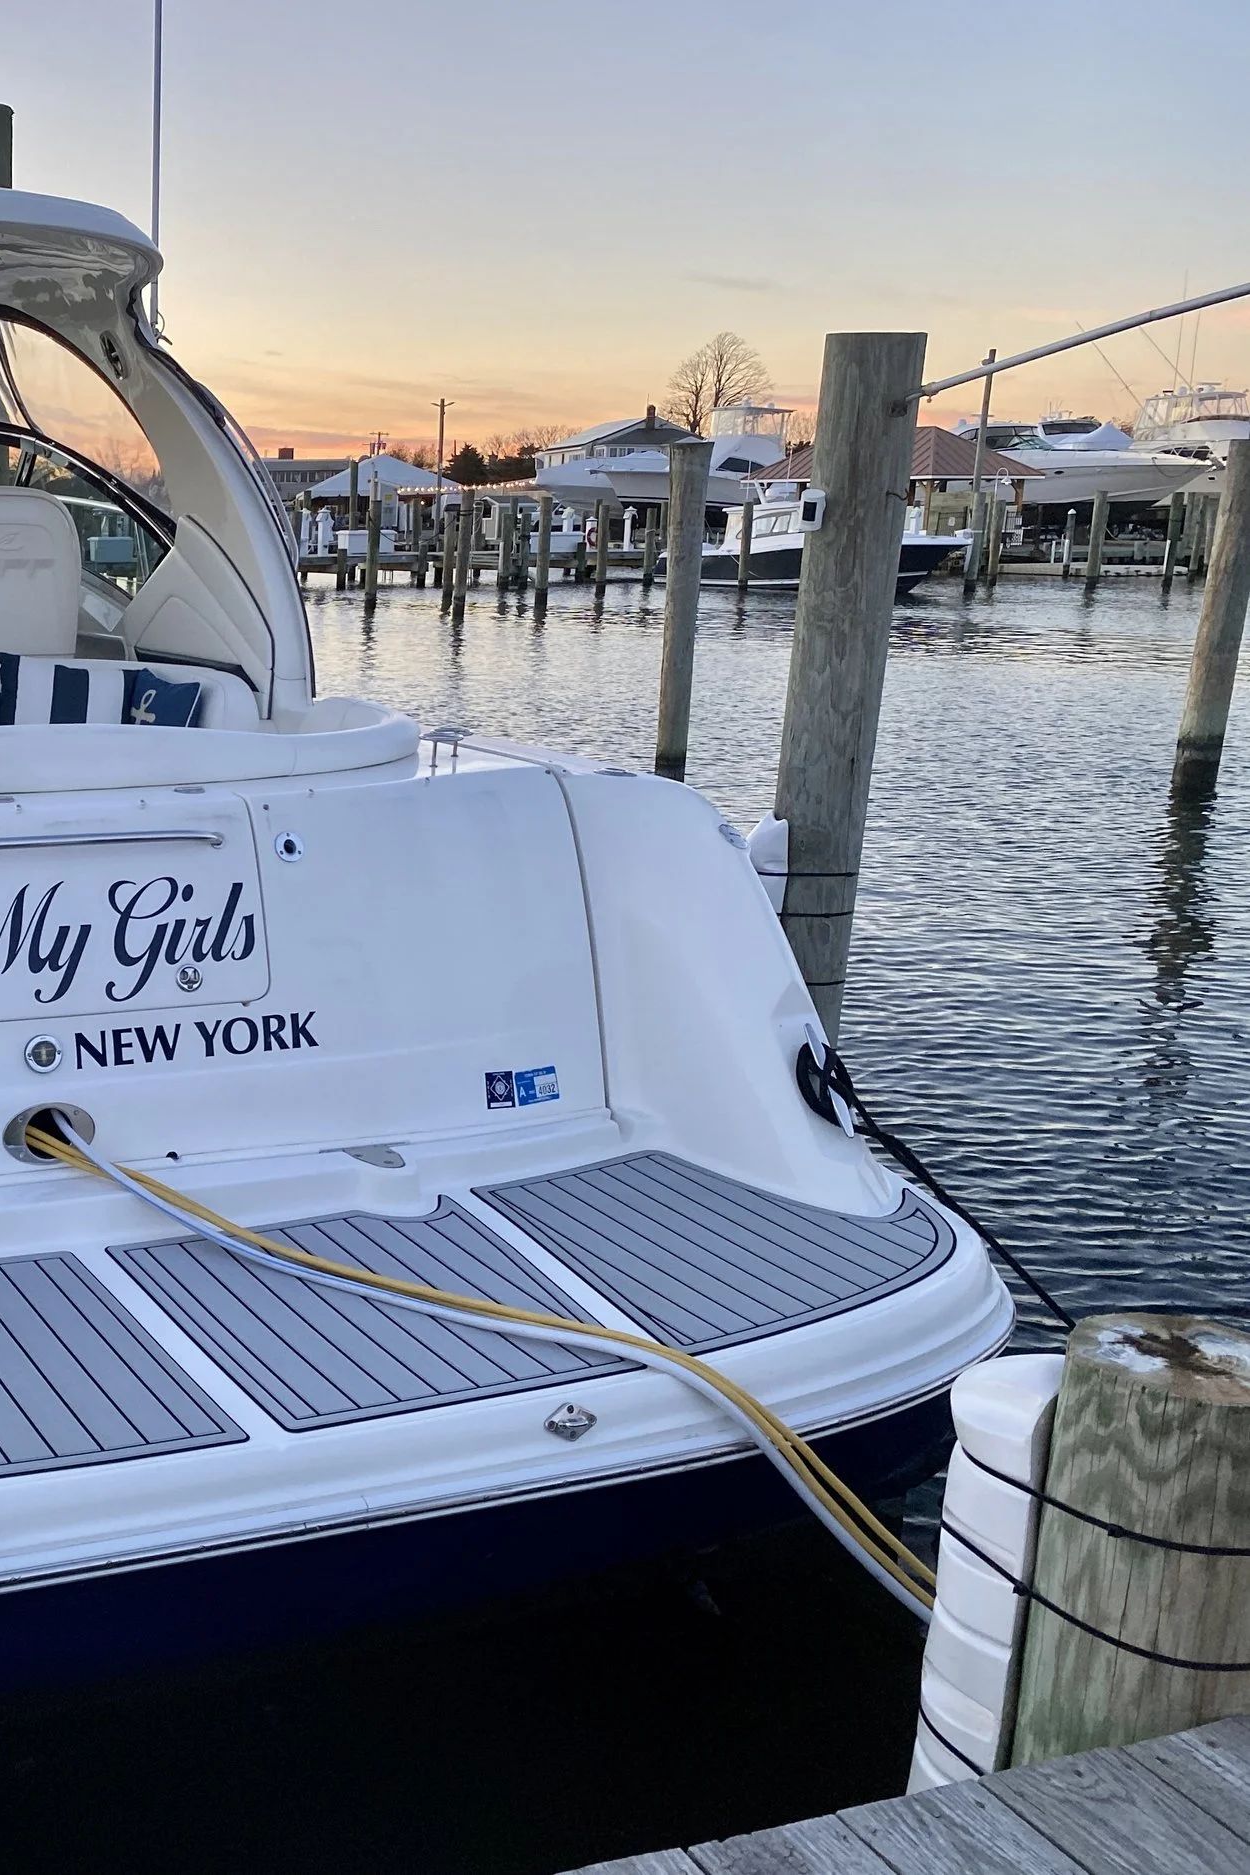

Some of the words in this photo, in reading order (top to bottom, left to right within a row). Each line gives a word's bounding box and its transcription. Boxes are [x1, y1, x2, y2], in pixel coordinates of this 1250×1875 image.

[105, 876, 256, 1003] Girls
[74, 1023, 182, 1070] NEW
[193, 1010, 320, 1058] YORK
